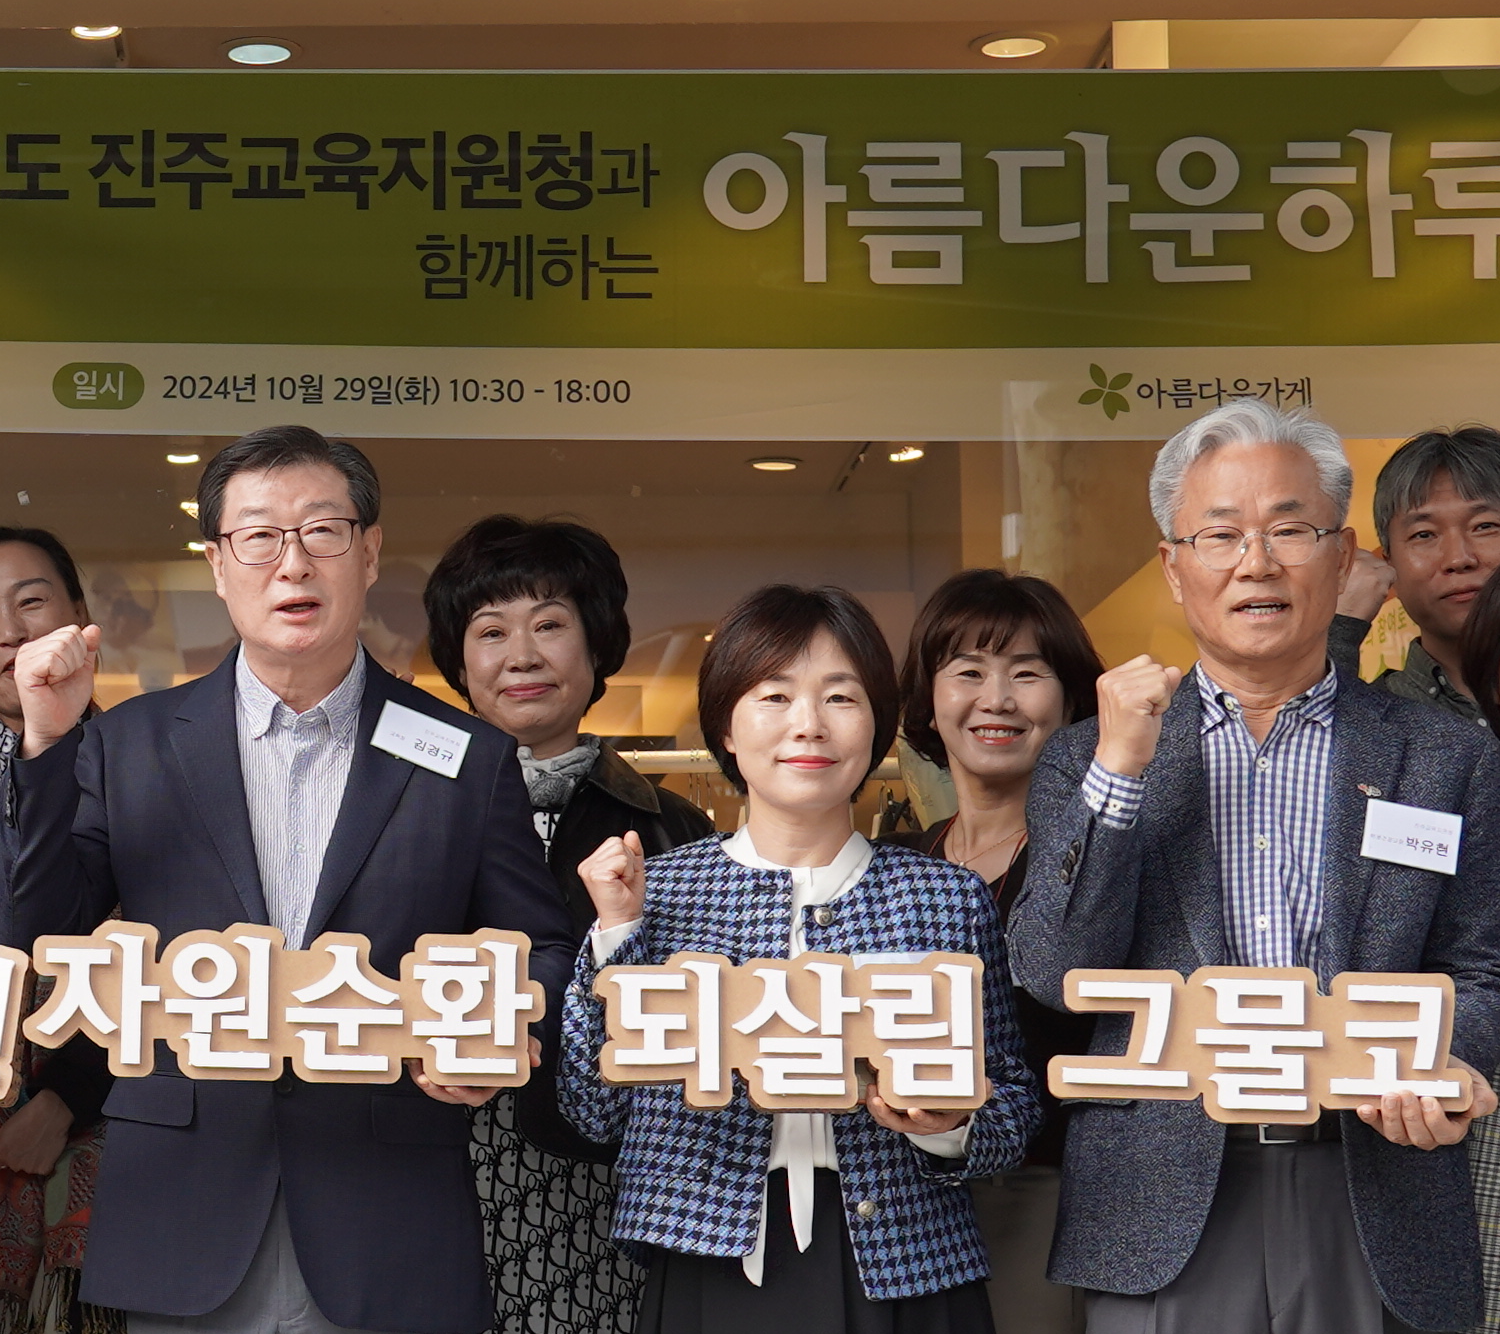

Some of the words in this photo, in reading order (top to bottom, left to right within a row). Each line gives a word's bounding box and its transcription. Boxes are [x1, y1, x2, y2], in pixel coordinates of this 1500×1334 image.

[86, 127, 662, 212] 진주교육지원청과
[414, 233, 660, 301] 함께하는
[72, 370, 125, 402] 일시
[161, 374, 257, 404] 2024년
[266, 374, 325, 404] 10월
[333, 374, 440, 407] 29일(화)
[448, 377, 525, 404] 10:30
[553, 378, 632, 405] 18:00
[1136, 376, 1313, 410] 아름다운가게
[413, 737, 454, 763] 김경규
[1406, 836, 1449, 858] 박유현
[612, 959, 976, 1097] 되살림
[1062, 977, 1461, 1110] 그물코
